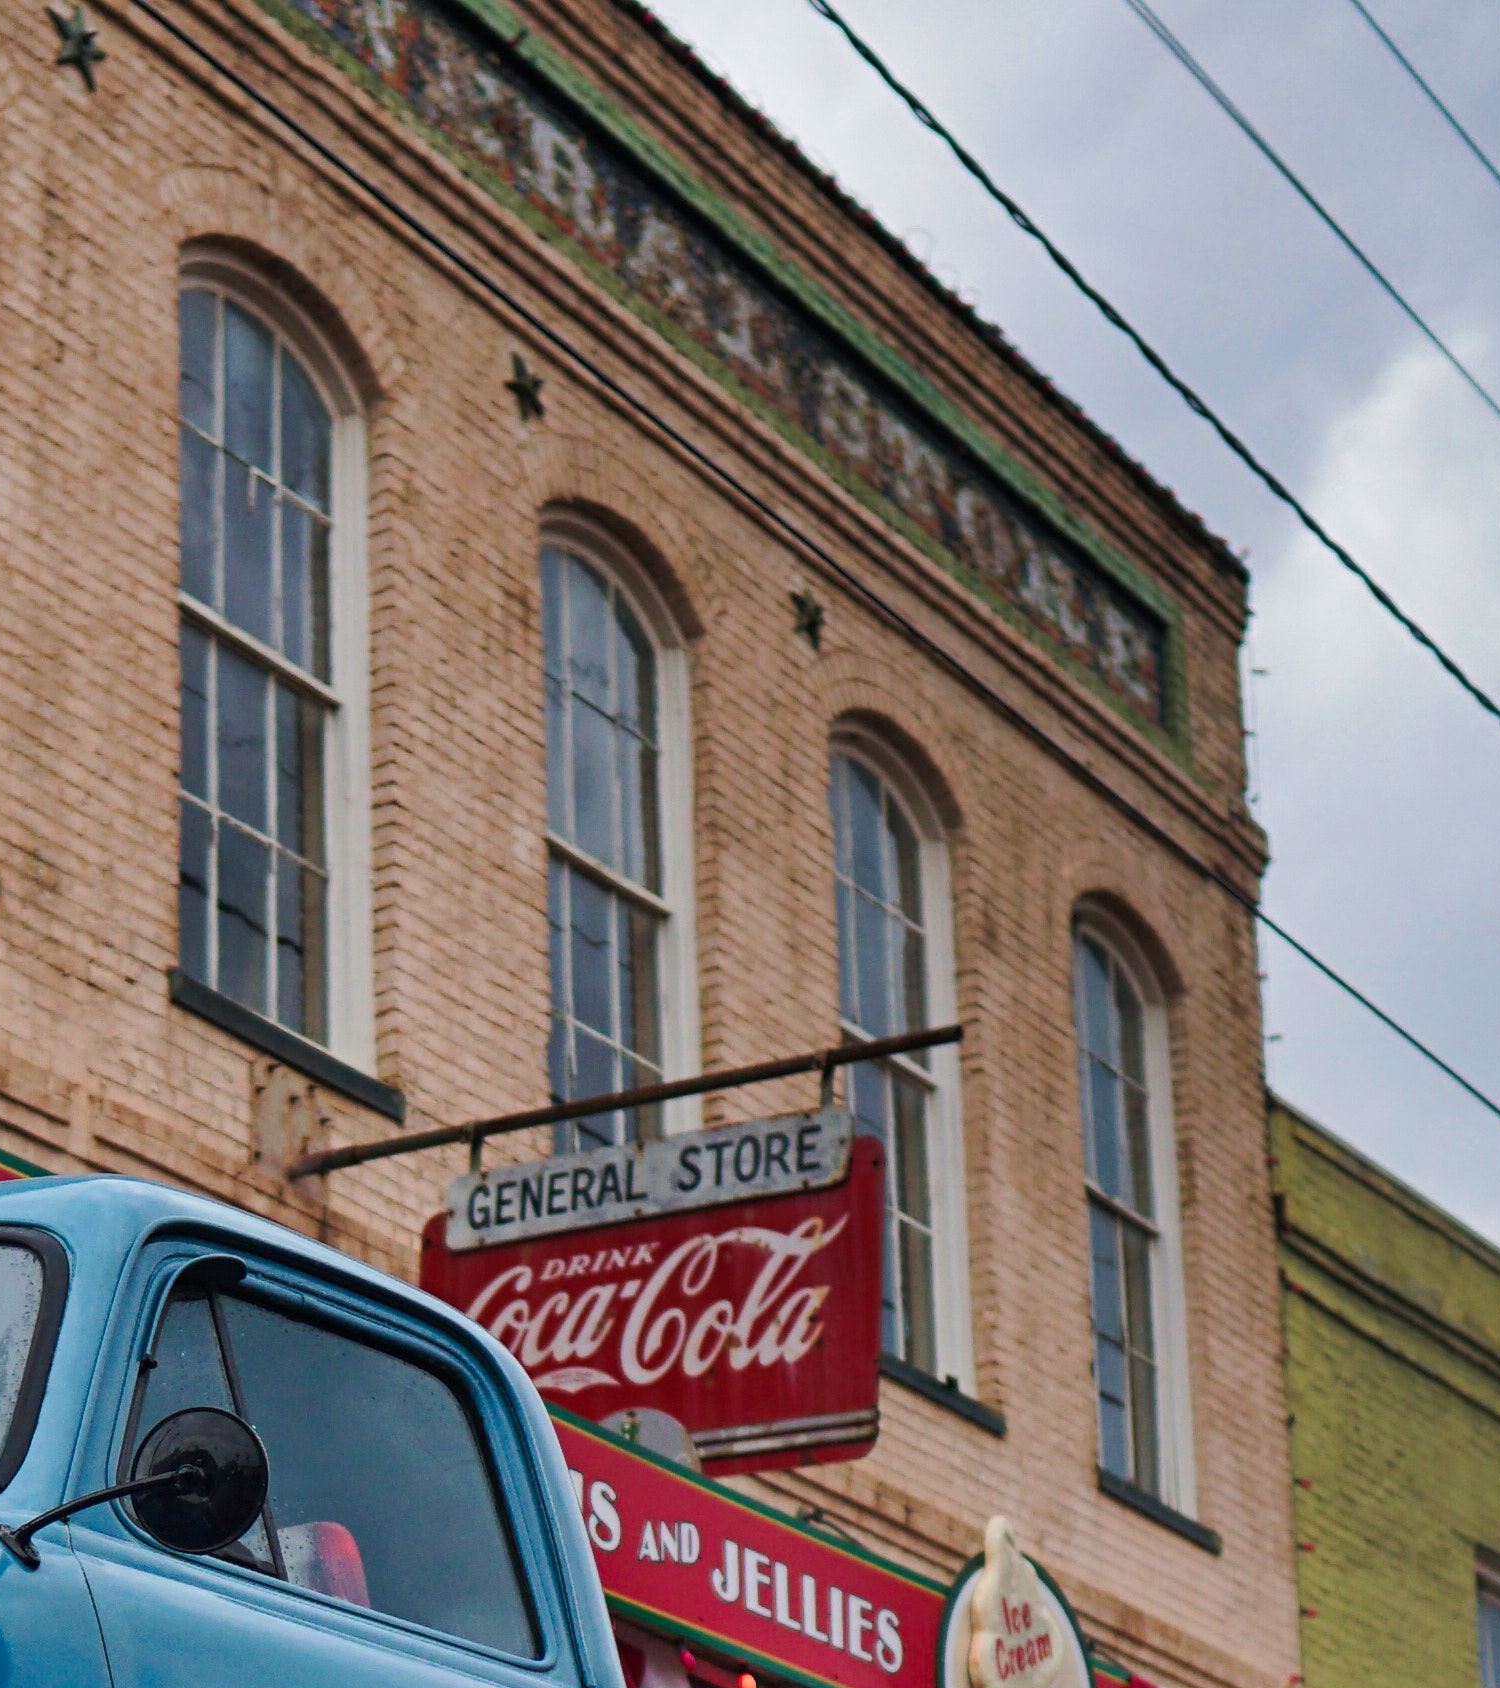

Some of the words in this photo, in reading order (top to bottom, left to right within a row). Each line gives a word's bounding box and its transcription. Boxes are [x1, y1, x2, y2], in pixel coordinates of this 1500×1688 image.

[466, 1159, 648, 1232] GENERAL
[676, 1124, 823, 1192] STORE
[465, 1213, 848, 1385] Coca-Cola
[540, 1241, 660, 1283] DRINK
[638, 1519, 701, 1565] AND
[711, 1538, 904, 1674] JELLIES
[1001, 1596, 1033, 1636] Ice
[994, 1631, 1054, 1681] Cream
